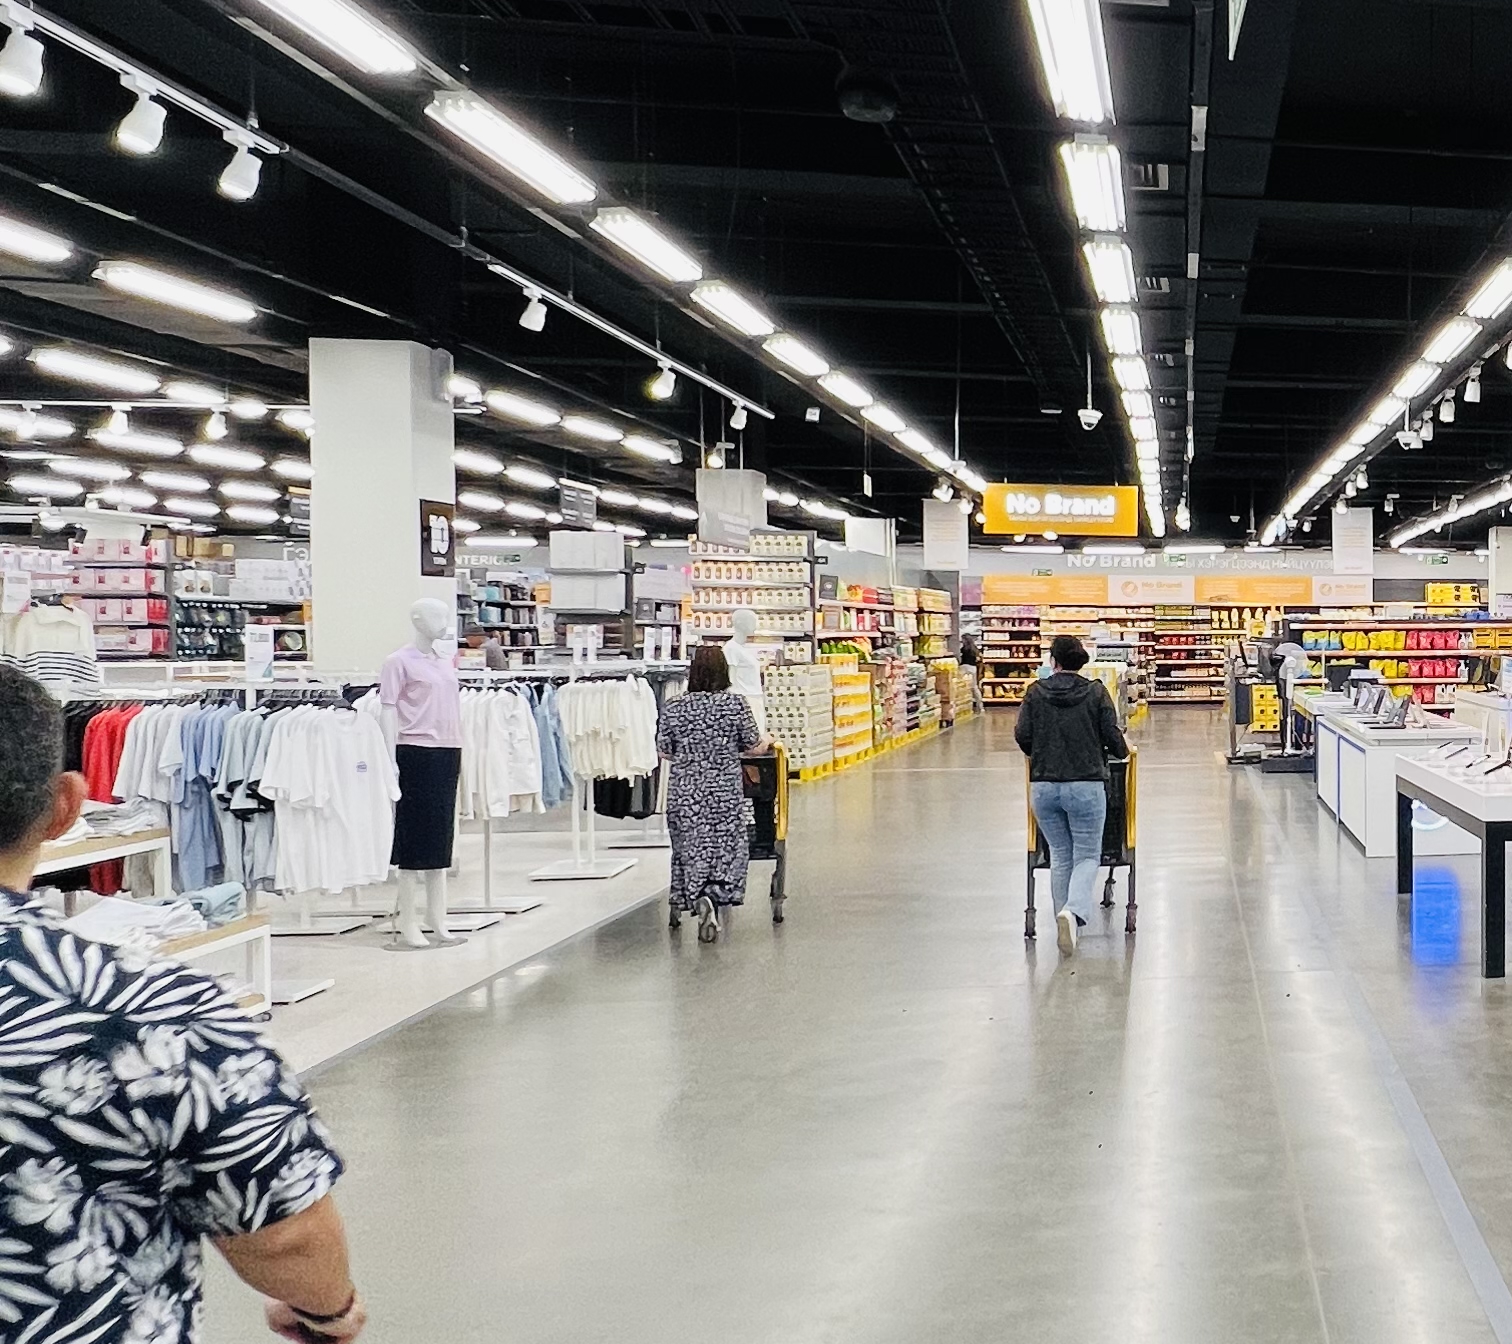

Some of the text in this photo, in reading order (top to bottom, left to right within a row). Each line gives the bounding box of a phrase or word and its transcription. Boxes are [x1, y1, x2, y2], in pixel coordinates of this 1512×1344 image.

[1006, 493, 1115, 516] No Brand
[1067, 554, 1095, 568] No
[1100, 554, 1156, 568] Brand
